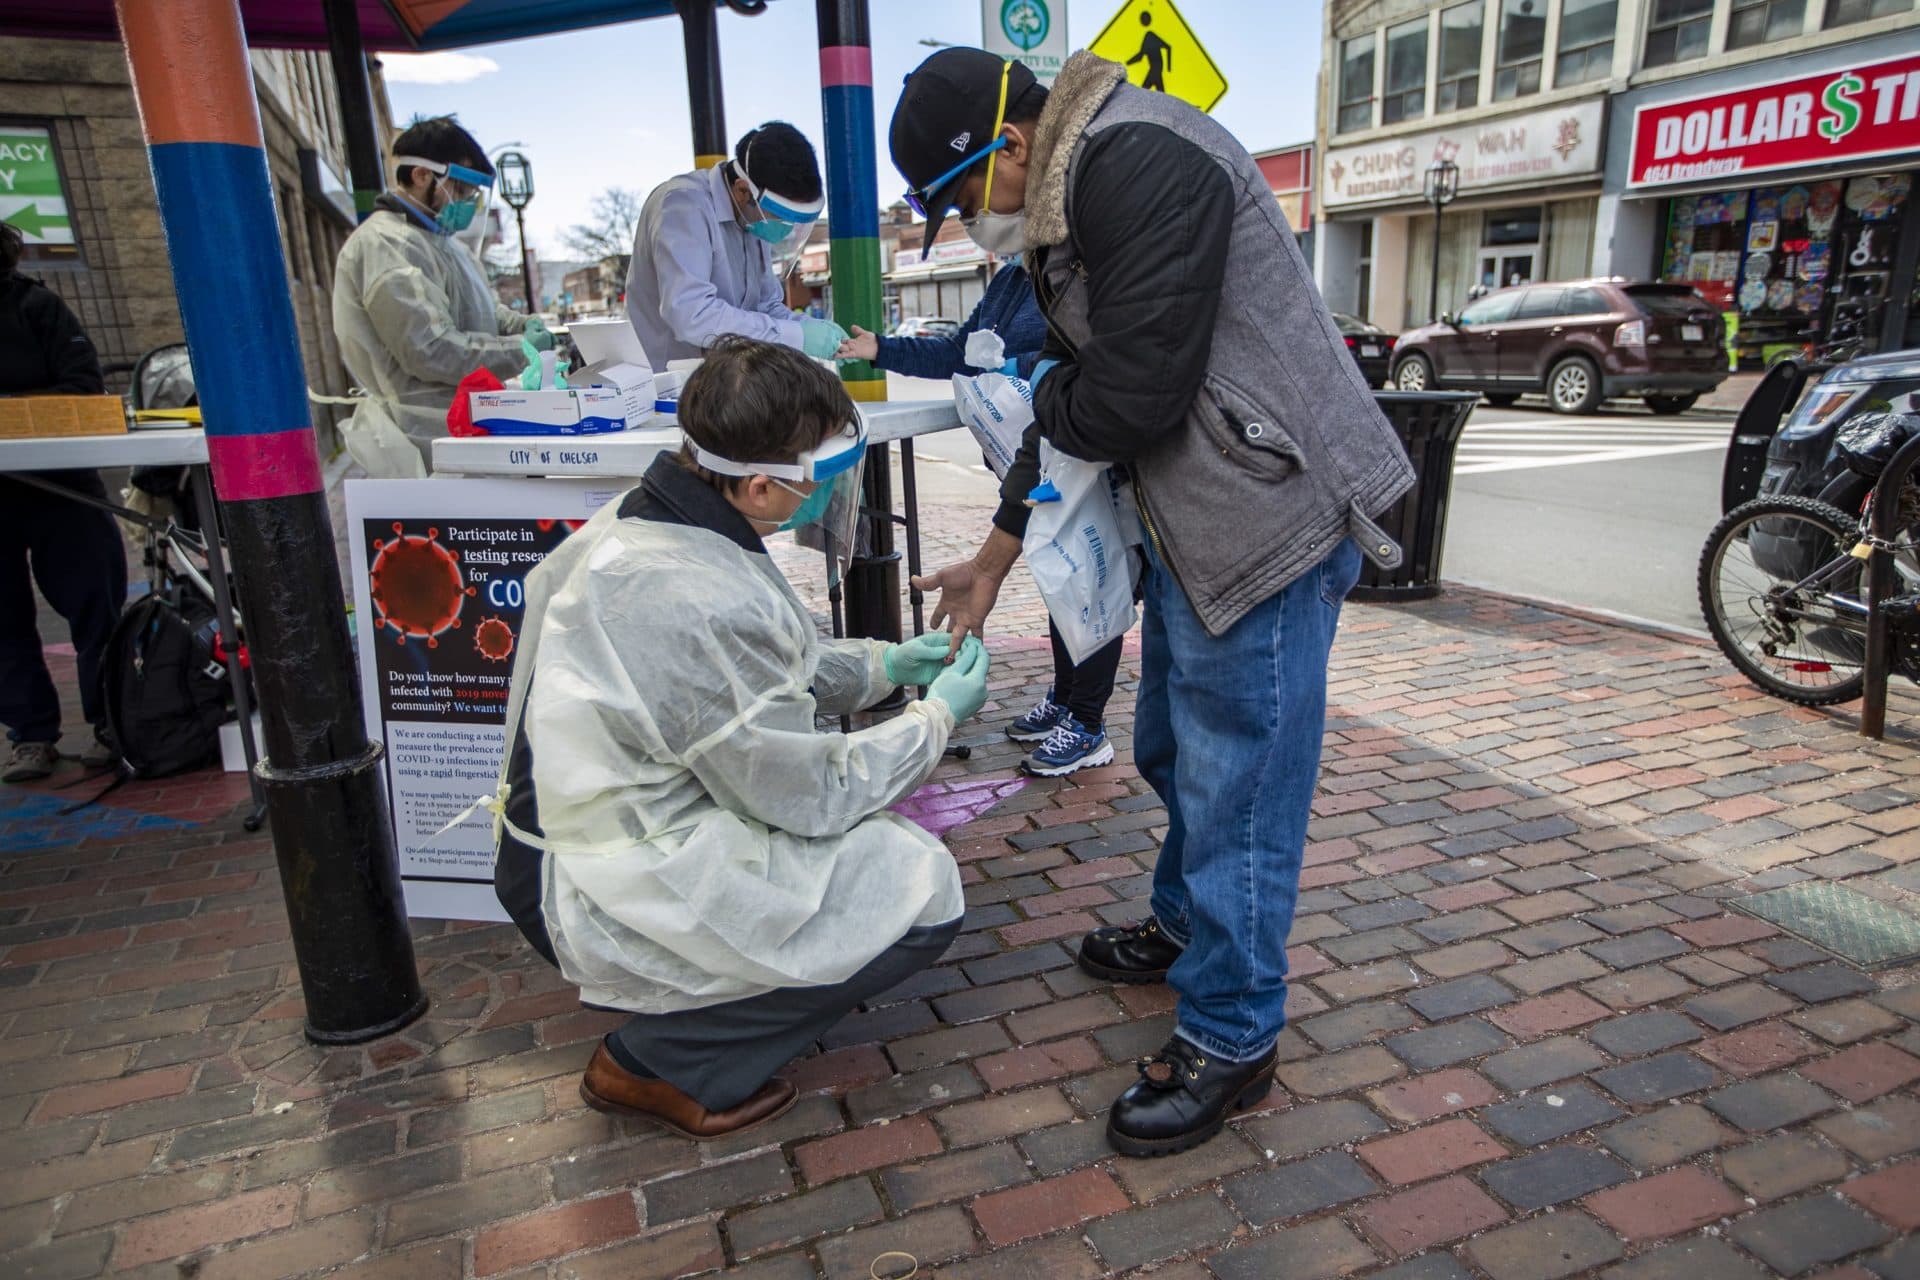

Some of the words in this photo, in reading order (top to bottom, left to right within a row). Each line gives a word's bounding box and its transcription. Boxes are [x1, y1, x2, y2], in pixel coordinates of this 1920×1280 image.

[1653, 92, 1815, 160] DOLLAR
[0, 143, 47, 162] ACY
[1352, 146, 1415, 176] CHUNG
[1478, 127, 1525, 155] WAH
[1643, 163, 1670, 182] 464
[1671, 156, 1744, 180] Broadway
[0, 168, 16, 191] Y
[510, 450, 530, 464] CITY
[541, 450, 551, 464] OF
[560, 451, 598, 465] CHELSEA
[448, 527, 518, 545] Participate
[521, 528, 535, 542] in
[464, 549, 509, 565] testing
[470, 568, 488, 582] for
[489, 579, 522, 607] CO
[389, 671, 405, 681] Do
[406, 673, 424, 683] you
[427, 672, 453, 682] know
[456, 672, 477, 683] how
[479, 675, 506, 687] many
[390, 685, 429, 697] infected
[432, 687, 453, 697] with
[456, 691, 479, 699] 2019
[392, 701, 451, 714] community?
[454, 702, 471, 712] We
[473, 703, 496, 713] want
[395, 729, 411, 738] We
[411, 730, 425, 738] are
[427, 730, 475, 742] conducting
[483, 732, 505, 743] study
[396, 743, 432, 752] measure
[433, 743, 447, 752] the
[449, 744, 494, 754] prevalence
[495, 744, 504, 754] of
[397, 755, 444, 765] COVID-19
[446, 756, 488, 766] infections
[490, 757, 499, 766] in
[398, 768, 421, 778] using
[430, 768, 452, 779] rapid
[454, 768, 499, 780] fingerstick
[400, 790, 414, 798] You
[431, 791, 453, 800] qualify
[437, 848, 475, 857] participants
[477, 850, 490, 858] may
